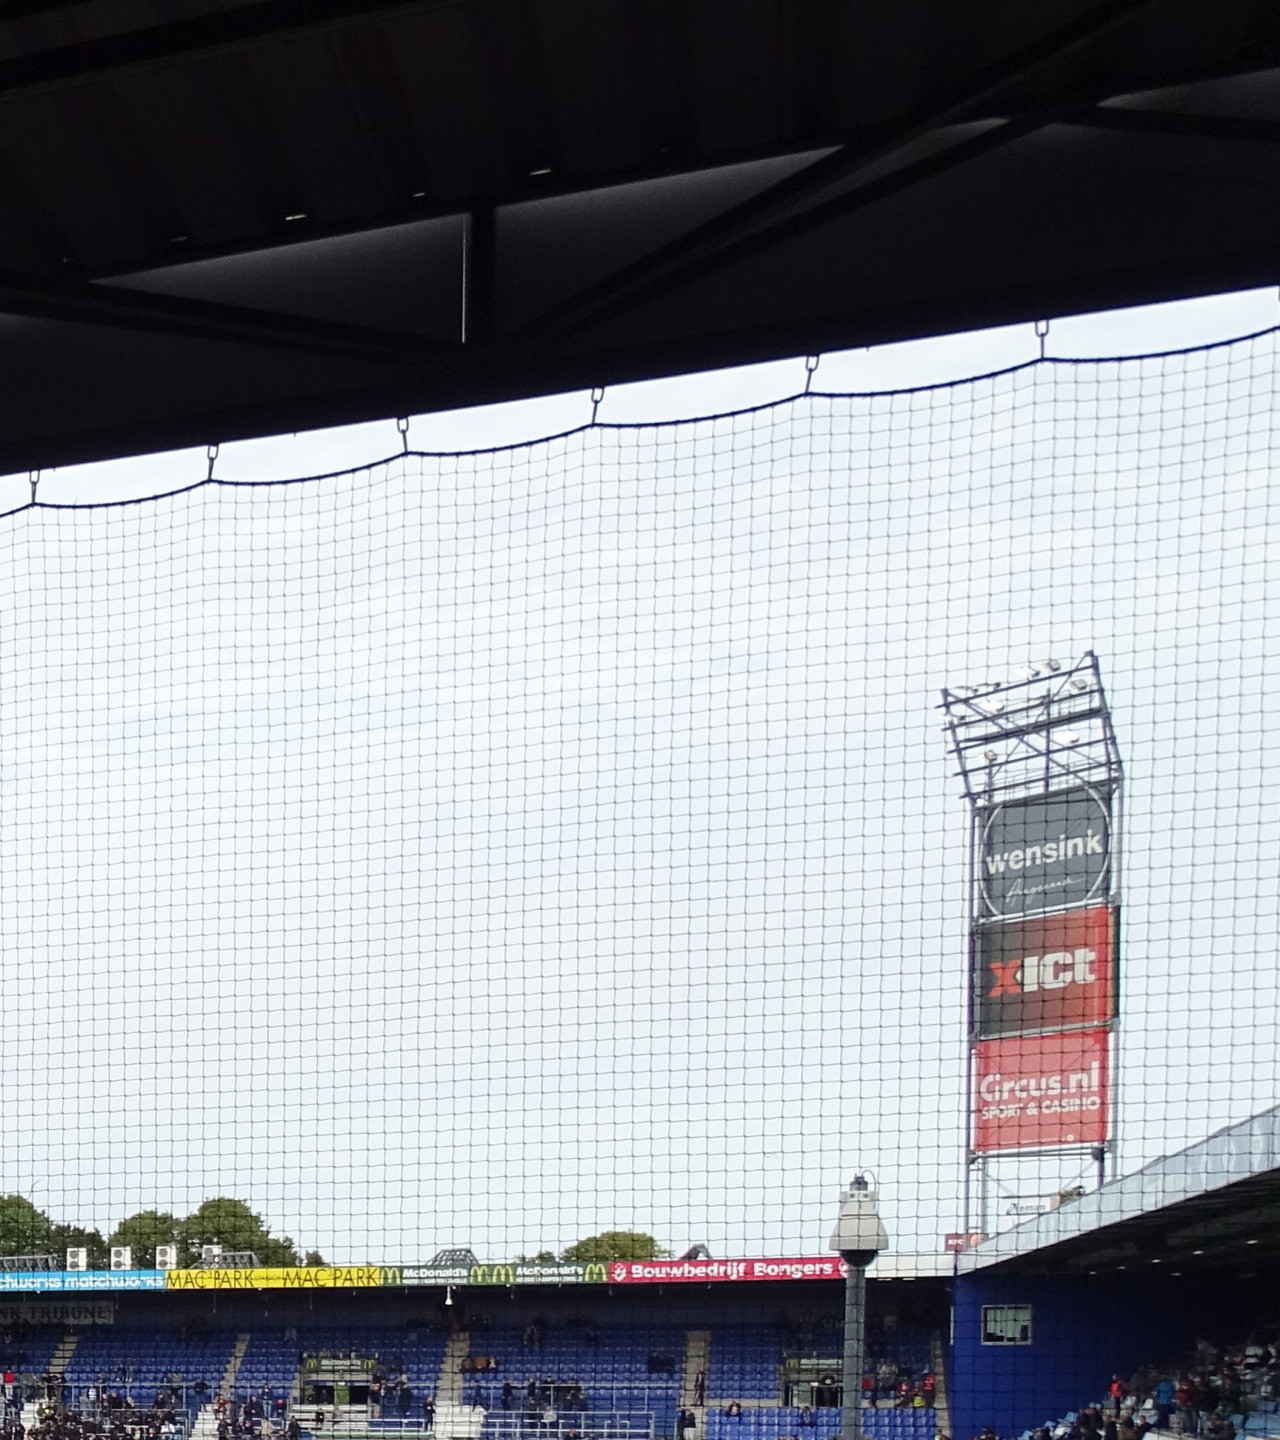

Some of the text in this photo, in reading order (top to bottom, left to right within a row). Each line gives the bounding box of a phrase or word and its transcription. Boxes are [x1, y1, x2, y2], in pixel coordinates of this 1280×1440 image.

[986, 829, 1103, 876] wensink
[980, 1061, 1099, 1102] Circus.nl
[981, 1095, 1100, 1121] SPORT & CASINO
[402, 1268, 468, 1278] McDonald's
[516, 1266, 584, 1276] McDonald's
[631, 1261, 834, 1280] Bouwbedrijf Bongers
[66, 1273, 164, 1288] matchworks
[29, 1307, 107, 1319] TRIBUNE
